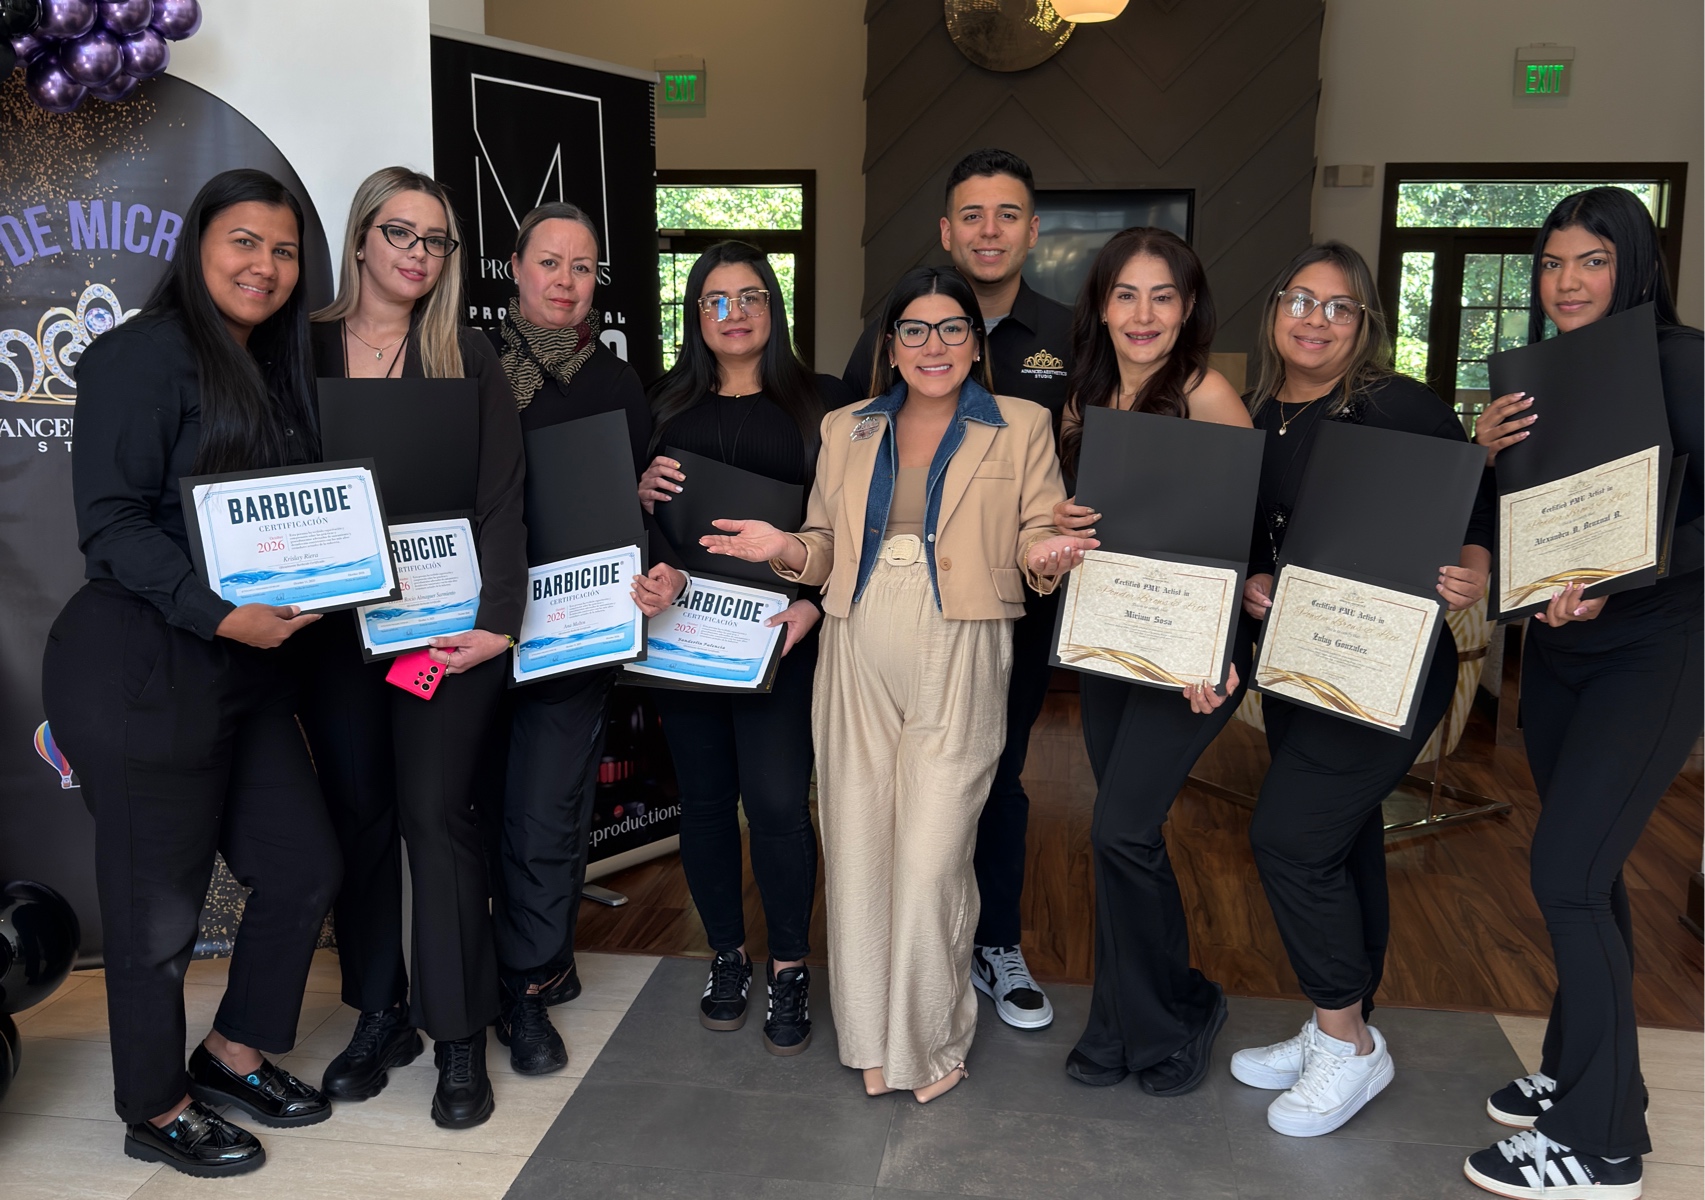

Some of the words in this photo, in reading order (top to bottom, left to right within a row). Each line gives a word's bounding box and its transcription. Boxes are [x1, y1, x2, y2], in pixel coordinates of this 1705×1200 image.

[664, 74, 697, 102] EXIT
[1525, 64, 1564, 94] EXIT
[0, 204, 62, 268] DE
[68, 199, 184, 262] MICR
[0, 418, 74, 438] ANCE
[227, 486, 350, 525] BARBICIDE
[1541, 502, 1567, 514] Certified
[1588, 488, 1605, 499] Artist
[258, 517, 328, 532] CERTIFICACIÓN
[257, 540, 285, 553] 2026
[391, 534, 457, 562] RBICIDE
[398, 562, 442, 574] RTIFICACIÓN
[400, 581, 410, 592] 26
[533, 562, 620, 601] BARBICIDE
[1115, 578, 1140, 588] Certified
[1162, 587, 1180, 596] Artist
[550, 590, 600, 606] CERTIFICACIÓN
[671, 590, 764, 623] ARBICIDE
[547, 610, 566, 623] 2026
[683, 612, 738, 627] CERTIFICACIÓN
[1124, 610, 1150, 622] Miriam
[1154, 616, 1172, 626] Sosa
[1312, 600, 1336, 611] Certified
[1357, 612, 1376, 622] Artist
[674, 623, 696, 634] 2026
[1334, 640, 1368, 654] Gonzalez
